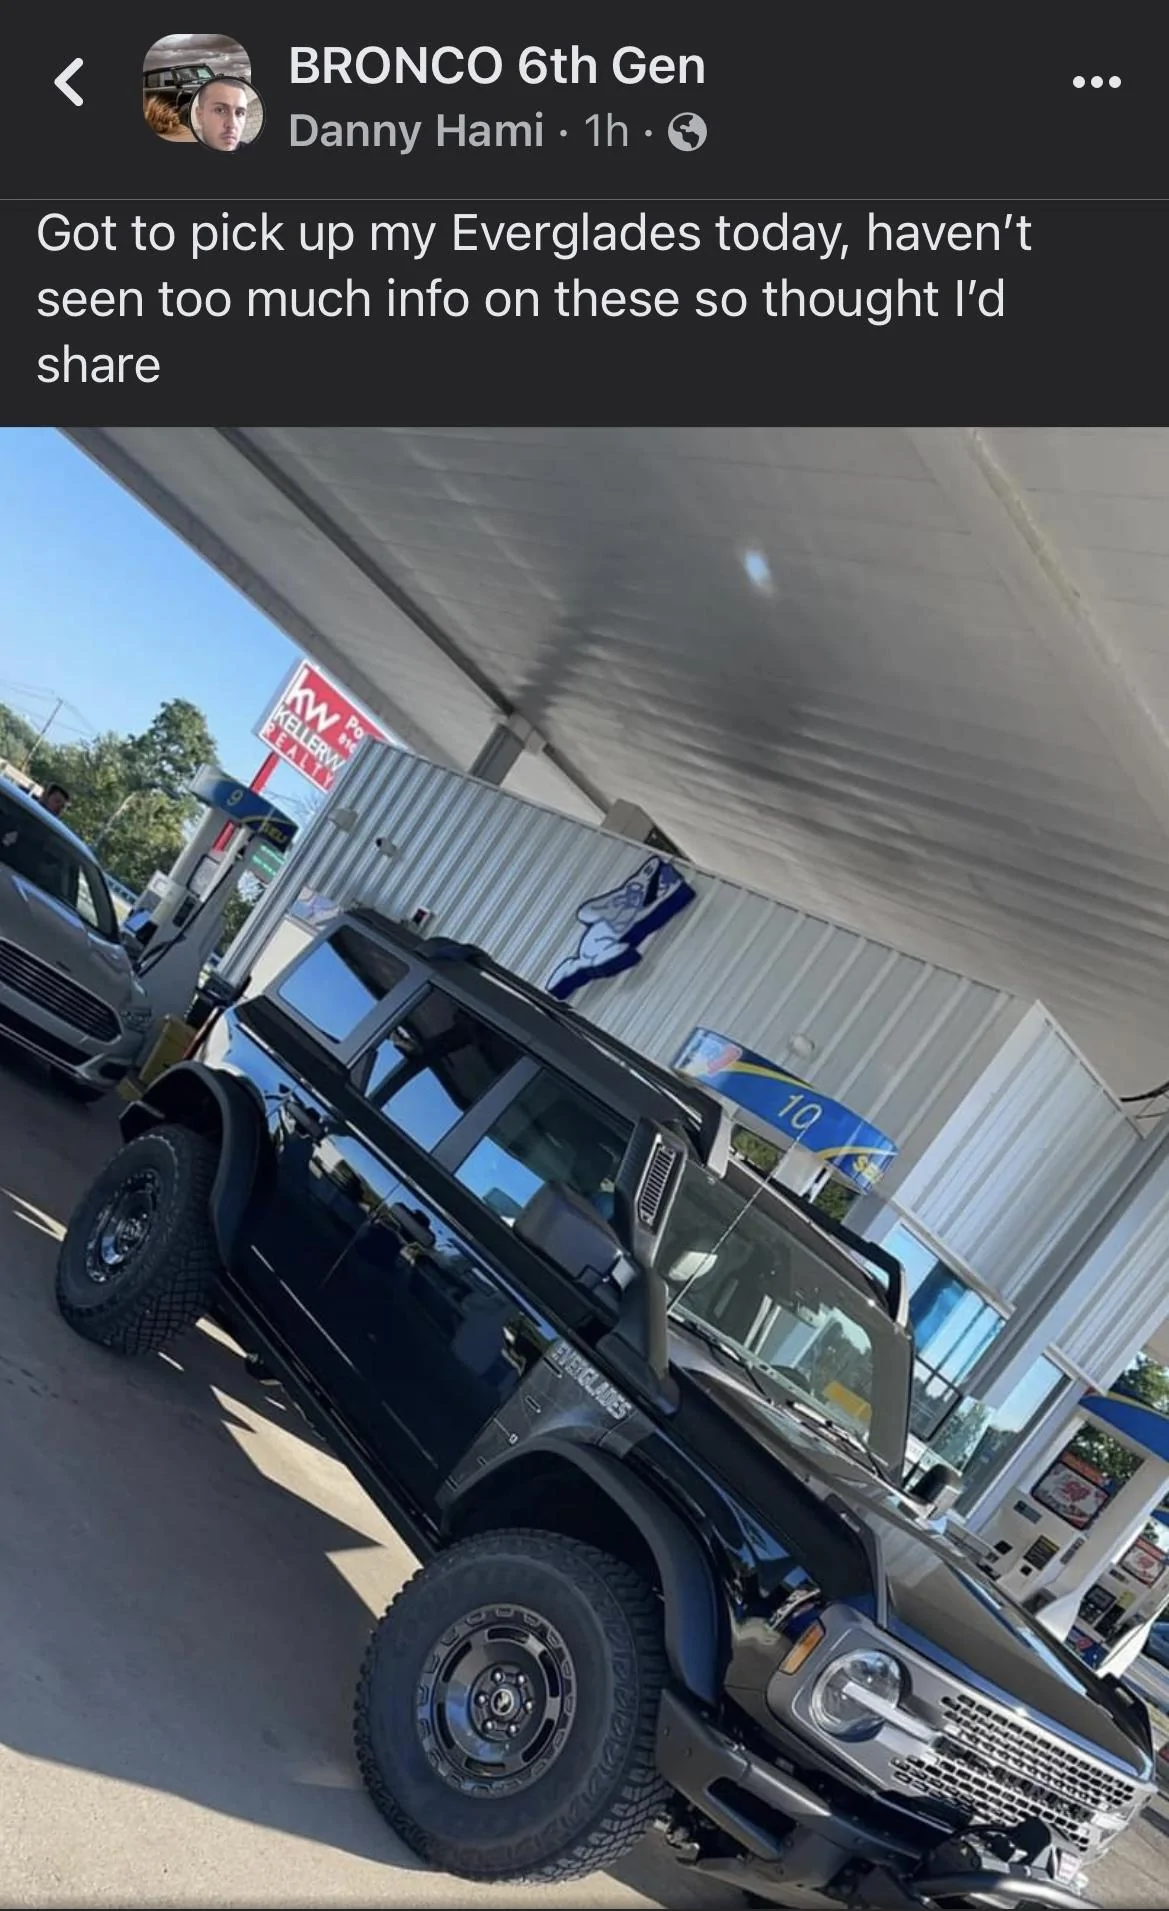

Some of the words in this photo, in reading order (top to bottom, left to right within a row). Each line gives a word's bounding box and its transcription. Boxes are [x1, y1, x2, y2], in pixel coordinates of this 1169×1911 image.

[264, 723, 334, 788] REALTY
[226, 788, 244, 806] 9
[778, 1094, 823, 1130] 10
[551, 1340, 632, 1420] EVERGLADES
